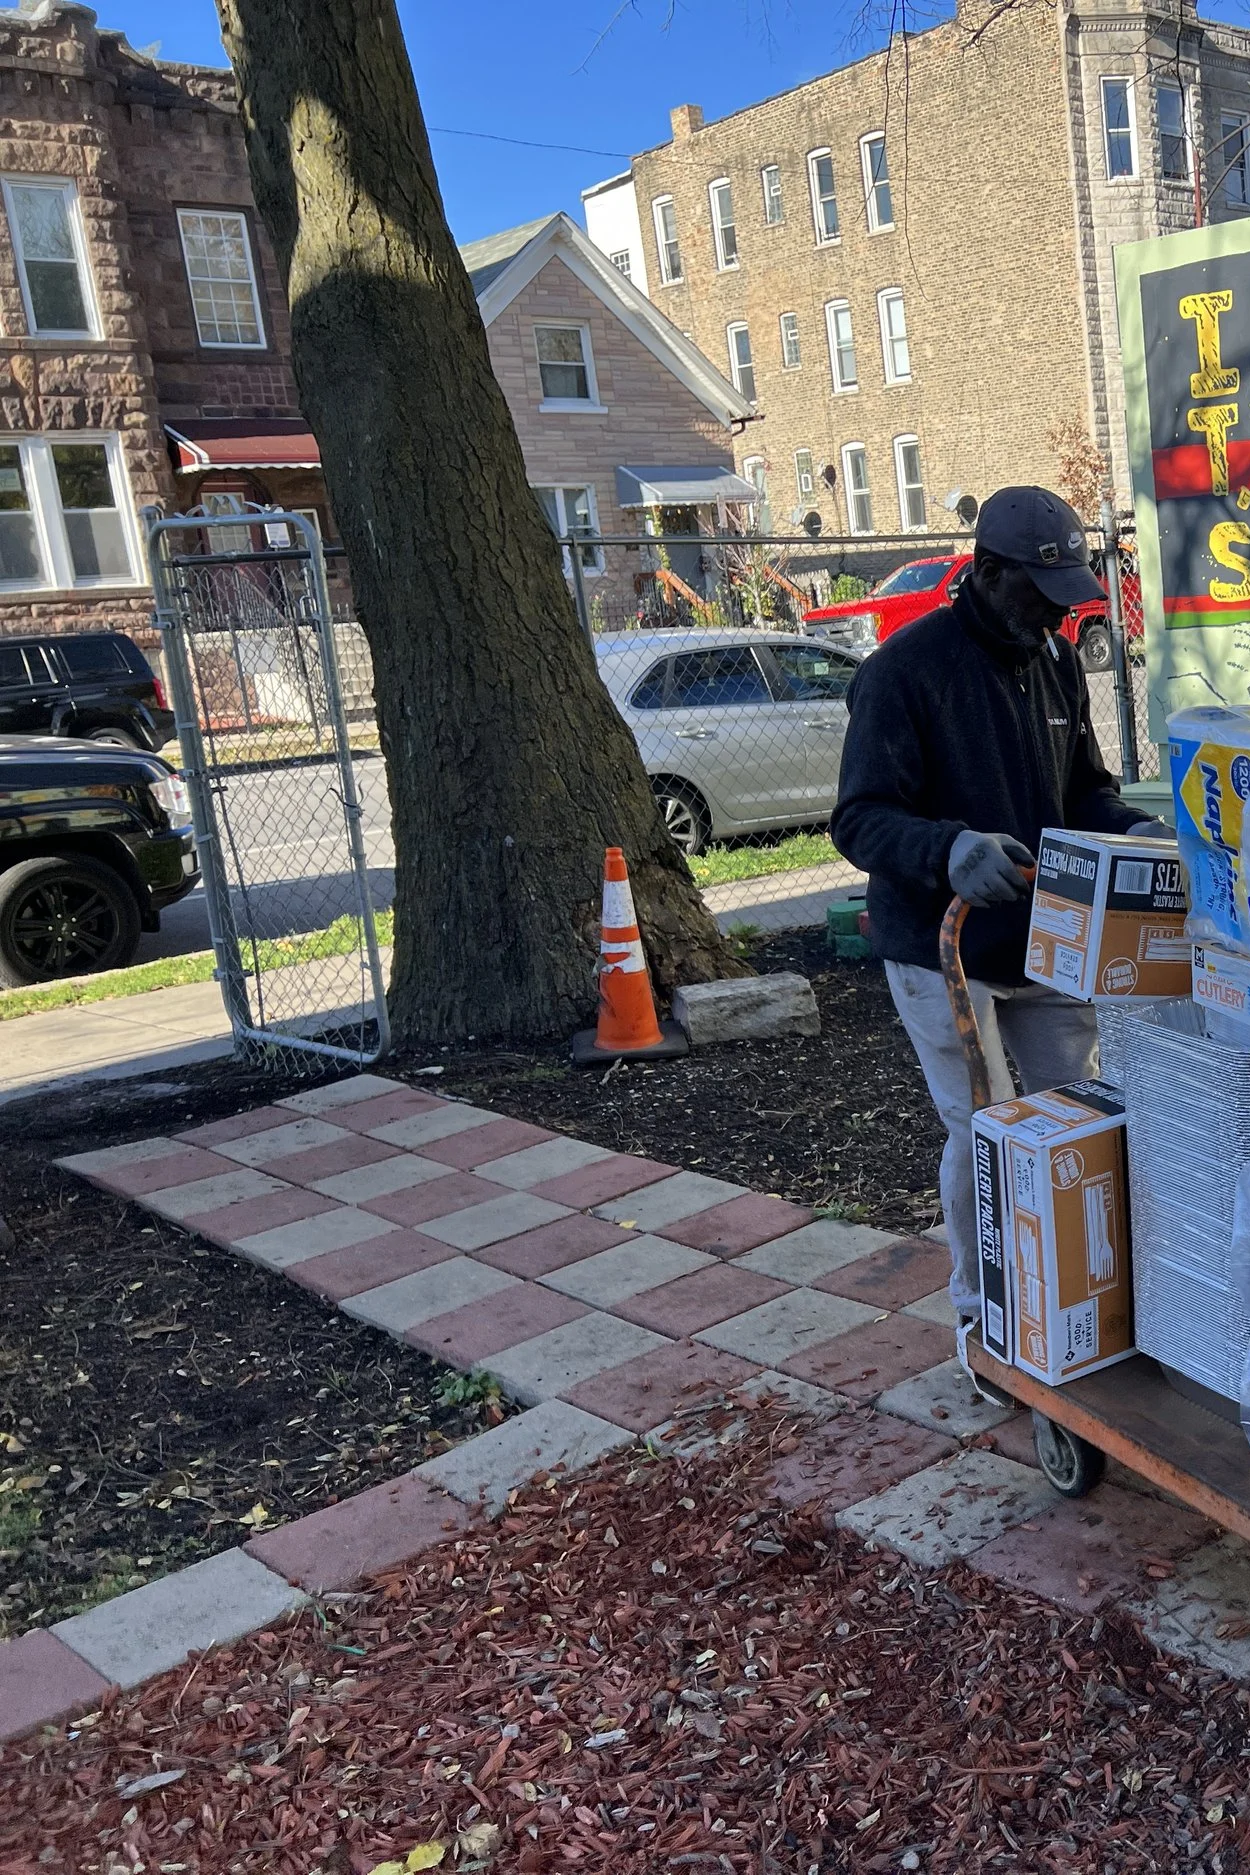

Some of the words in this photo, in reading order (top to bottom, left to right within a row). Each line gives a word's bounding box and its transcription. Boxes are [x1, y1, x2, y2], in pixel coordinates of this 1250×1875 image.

[1239, 758, 1250, 799] 1200
[1041, 847, 1068, 874] PACKETS
[1067, 854, 1096, 881] CUTLERY
[1196, 978, 1246, 1009] CUTLERY
[976, 1137, 992, 1203] CUTLERY
[980, 1201, 996, 1265] PACKETS
[1074, 1322, 1082, 1345] FOOD
[1085, 1311, 1093, 1348] SERVICE
